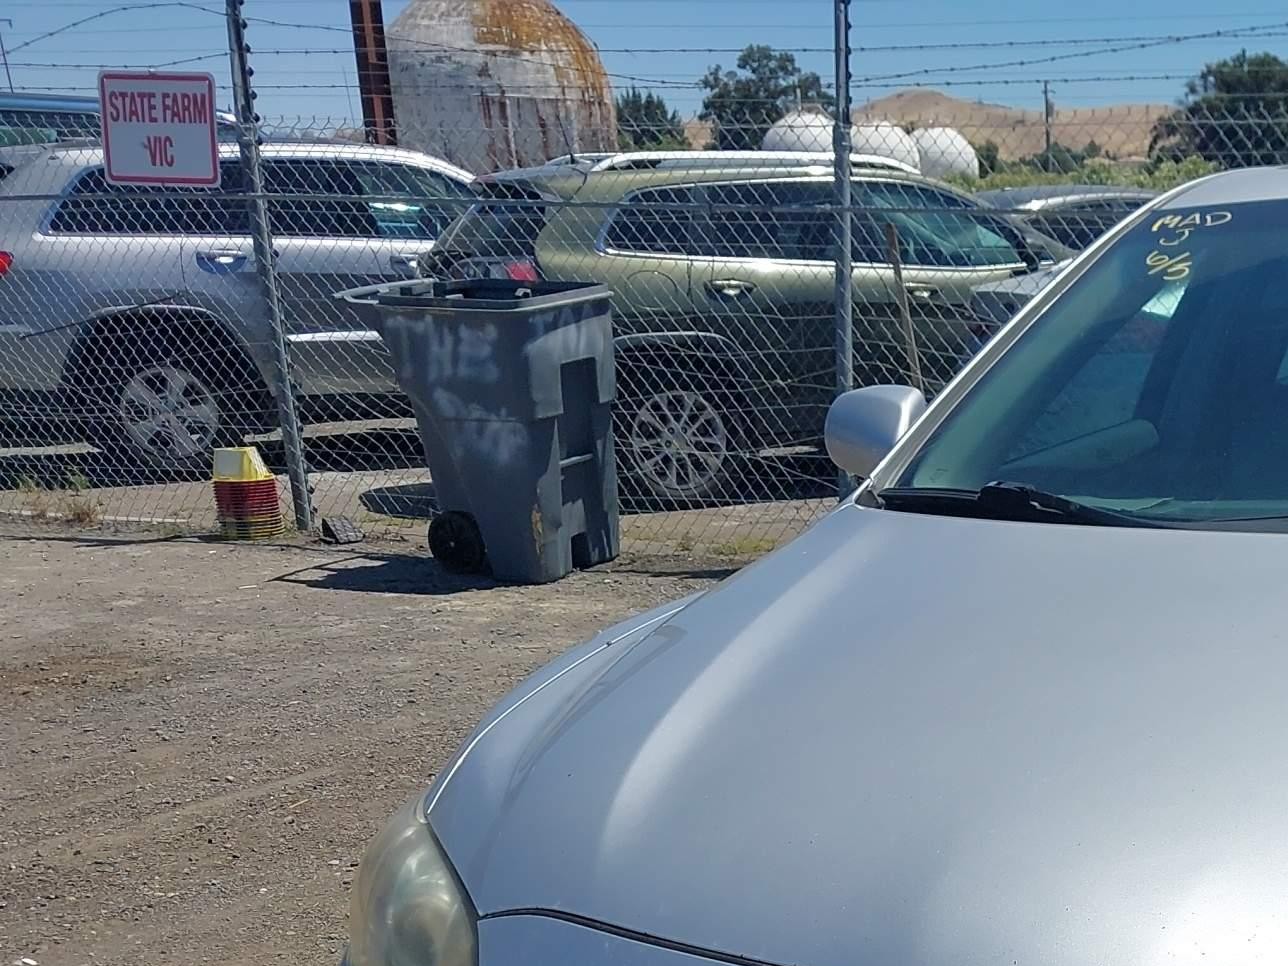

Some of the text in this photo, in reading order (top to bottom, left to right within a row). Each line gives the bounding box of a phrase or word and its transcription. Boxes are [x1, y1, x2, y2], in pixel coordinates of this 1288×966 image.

[108, 91, 208, 124] STATE FARM
[146, 135, 175, 168] VIC
[1151, 211, 1233, 232] MAD
